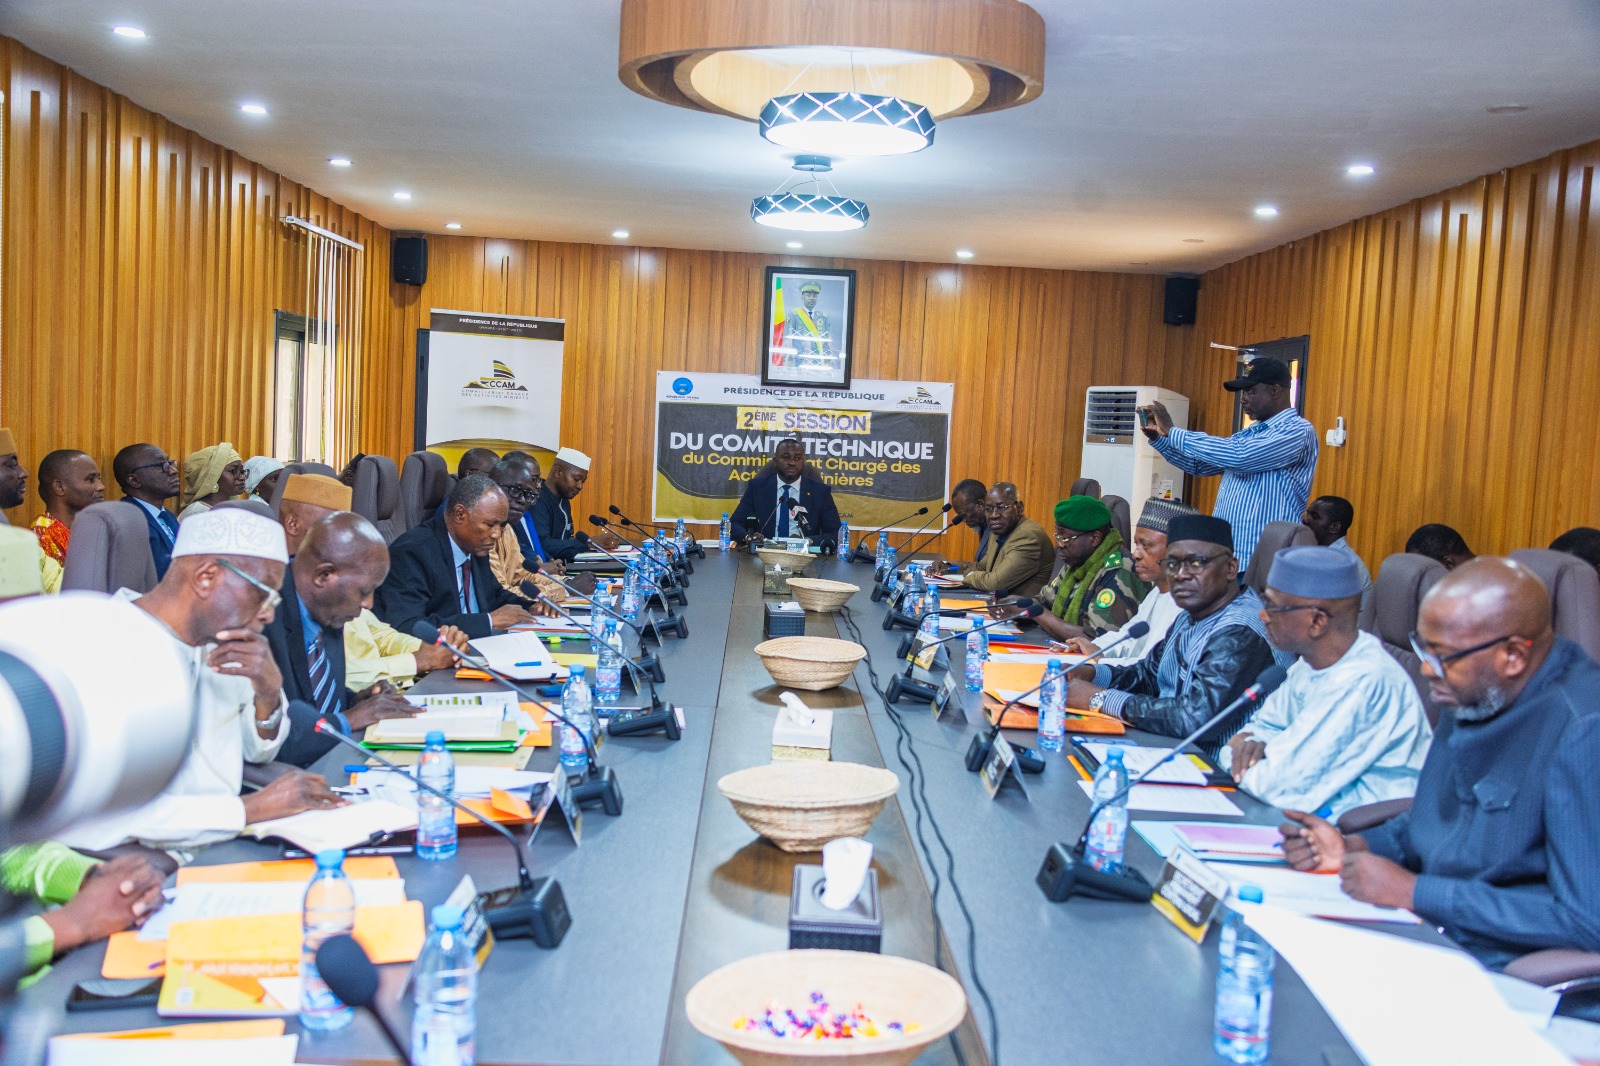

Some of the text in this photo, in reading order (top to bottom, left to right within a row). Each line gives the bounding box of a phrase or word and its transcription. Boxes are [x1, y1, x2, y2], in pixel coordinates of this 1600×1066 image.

[490, 380, 516, 388] CCAM
[723, 386, 786, 397] PRÉSIDENCE
[805, 390, 819, 398] LA
[821, 390, 886, 401] RÉPUBLIQUE
[783, 411, 867, 432] SESSION
[669, 432, 704, 451] DU
[801, 437, 934, 460] TECHNIQUE
[682, 451, 704, 465] du
[825, 457, 888, 475] Chargé
[890, 460, 921, 474] des
[820, 471, 874, 487] inières
